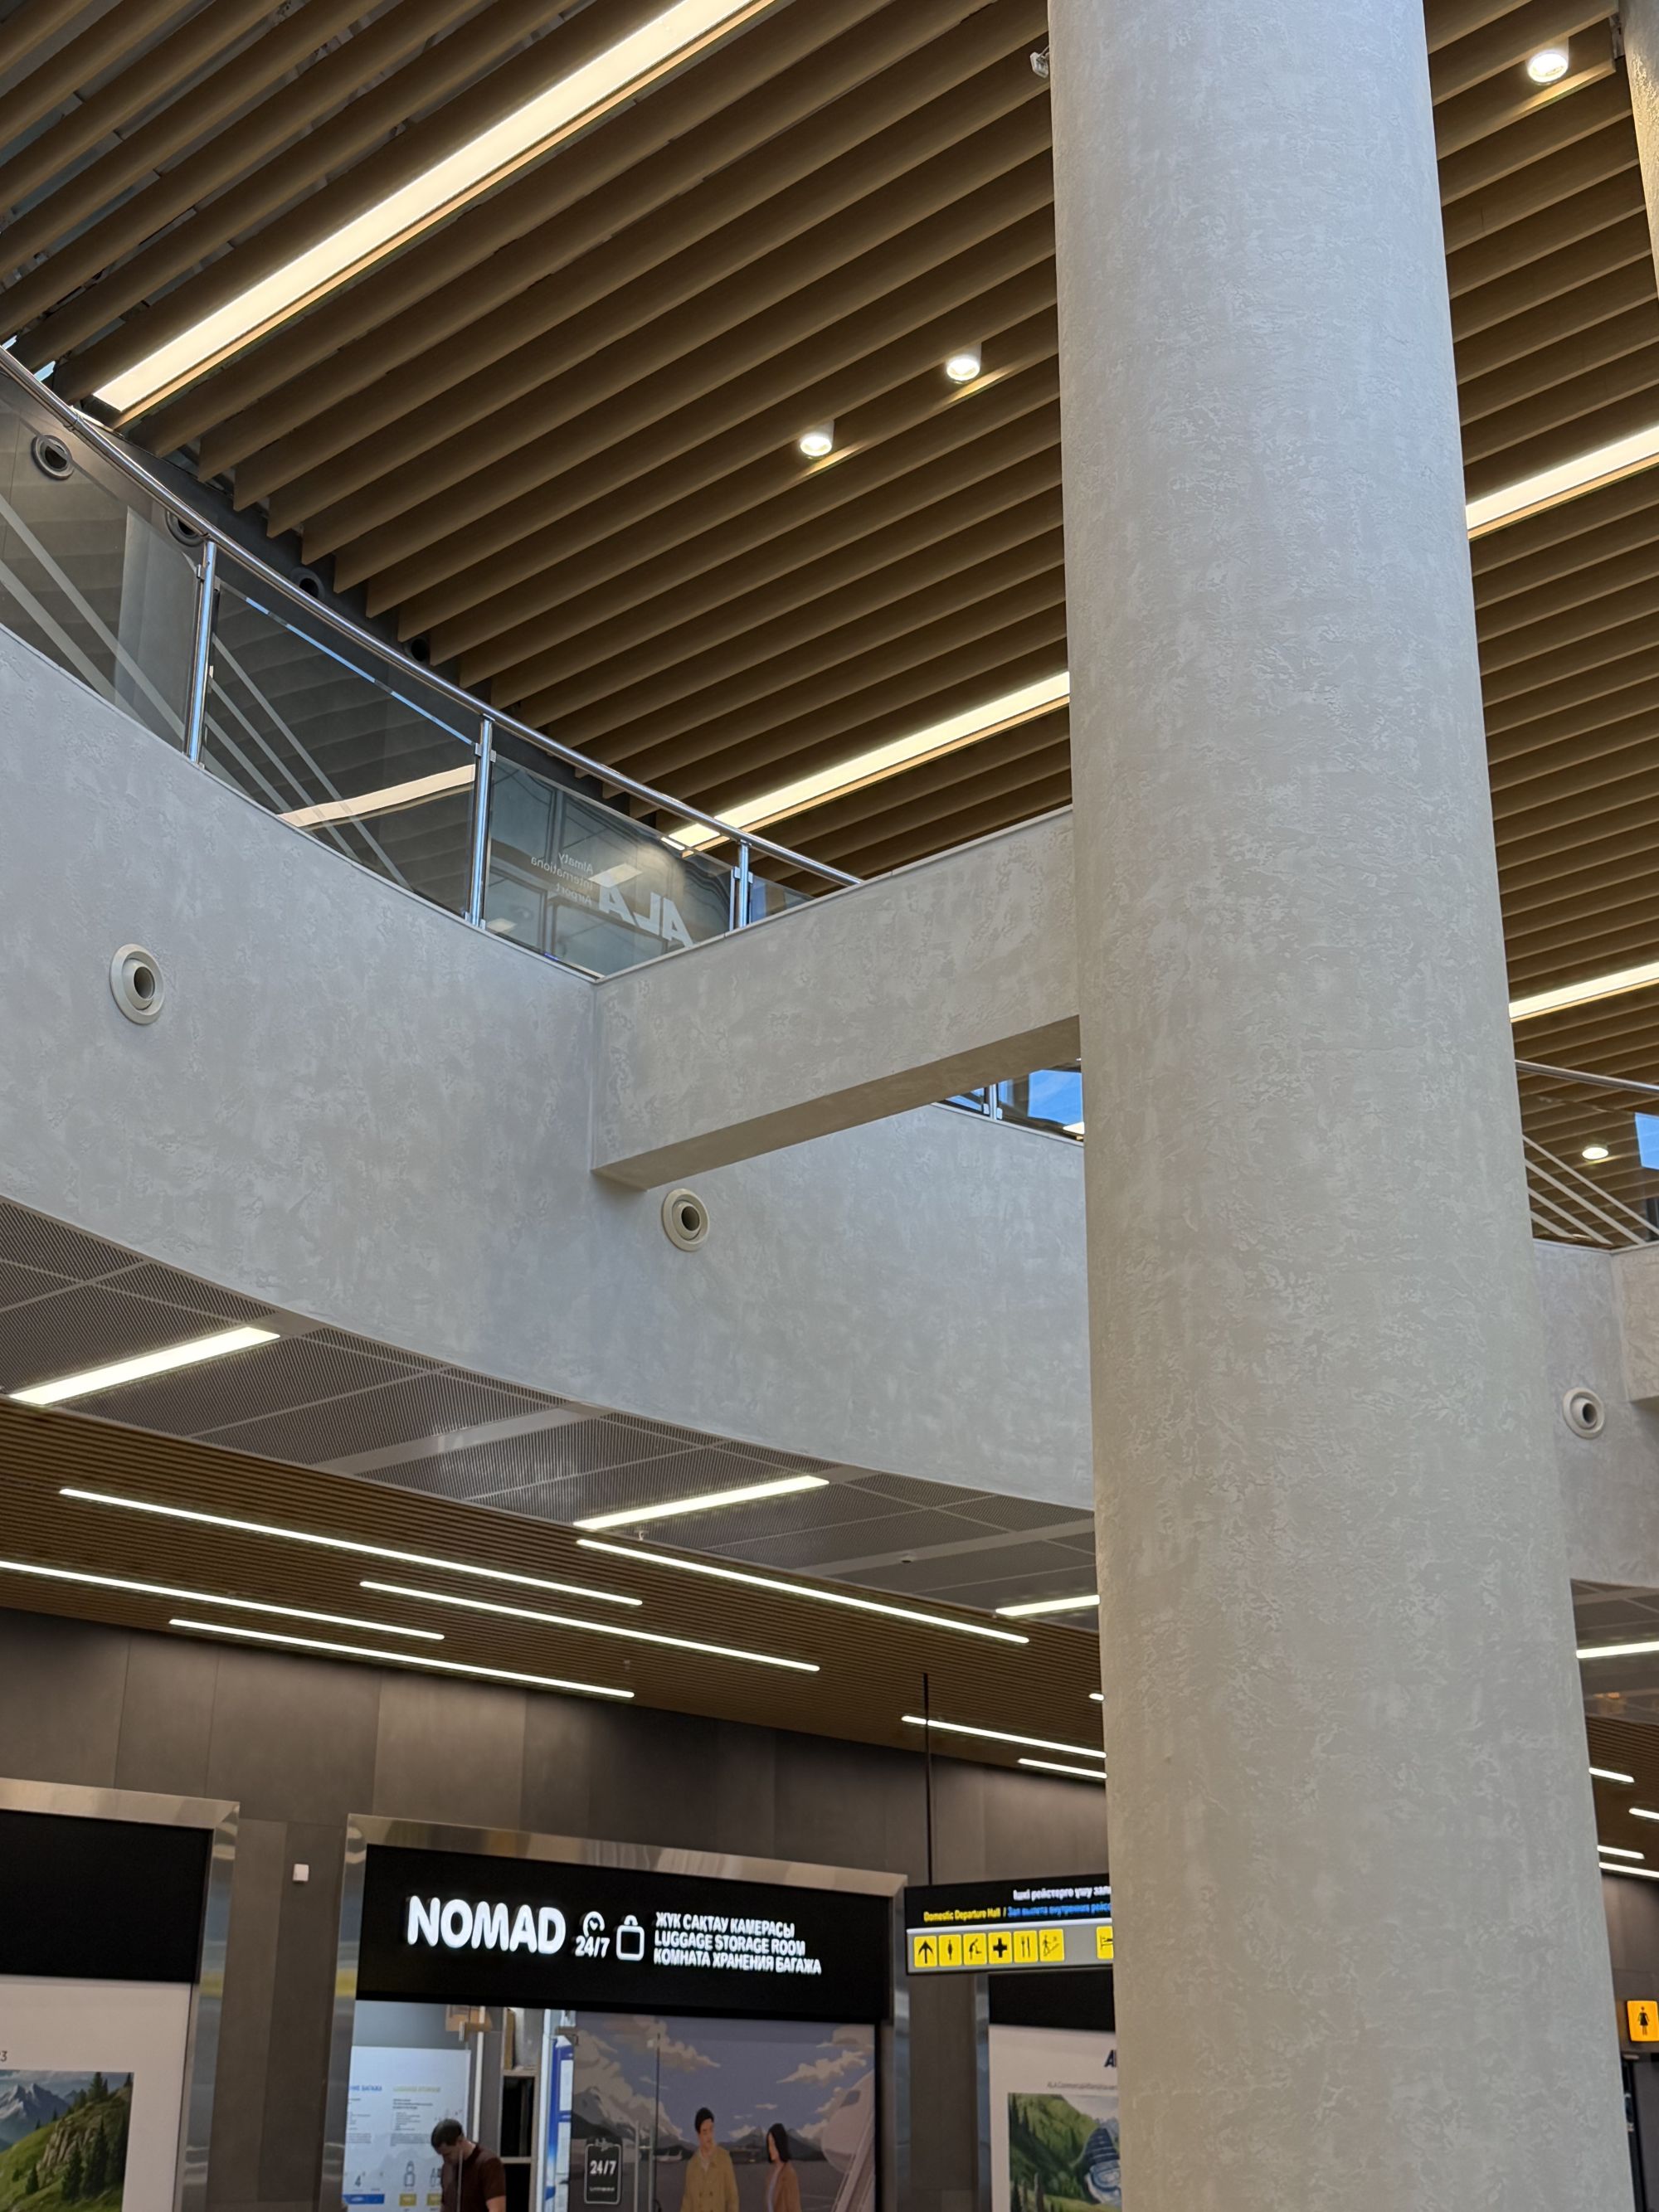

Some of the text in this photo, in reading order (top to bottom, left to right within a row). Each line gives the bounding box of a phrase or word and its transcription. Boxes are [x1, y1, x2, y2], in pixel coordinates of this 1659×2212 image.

[407, 1895, 566, 1954] NOMAD
[923, 1911, 954, 1923] Domestic
[955, 1909, 986, 1923] Departure
[987, 1908, 1000, 1918] Hall
[730, 1918, 795, 1939] КАМЕРАСЫ
[575, 1935, 611, 1957] 24/7
[654, 1929, 805, 1957] LUGGAGE STORAGE ROOM
[654, 1947, 821, 1975] КОМНАТА ХРАНЕНИЯ БАГАЖА
[590, 2159, 616, 2176] 24/7
